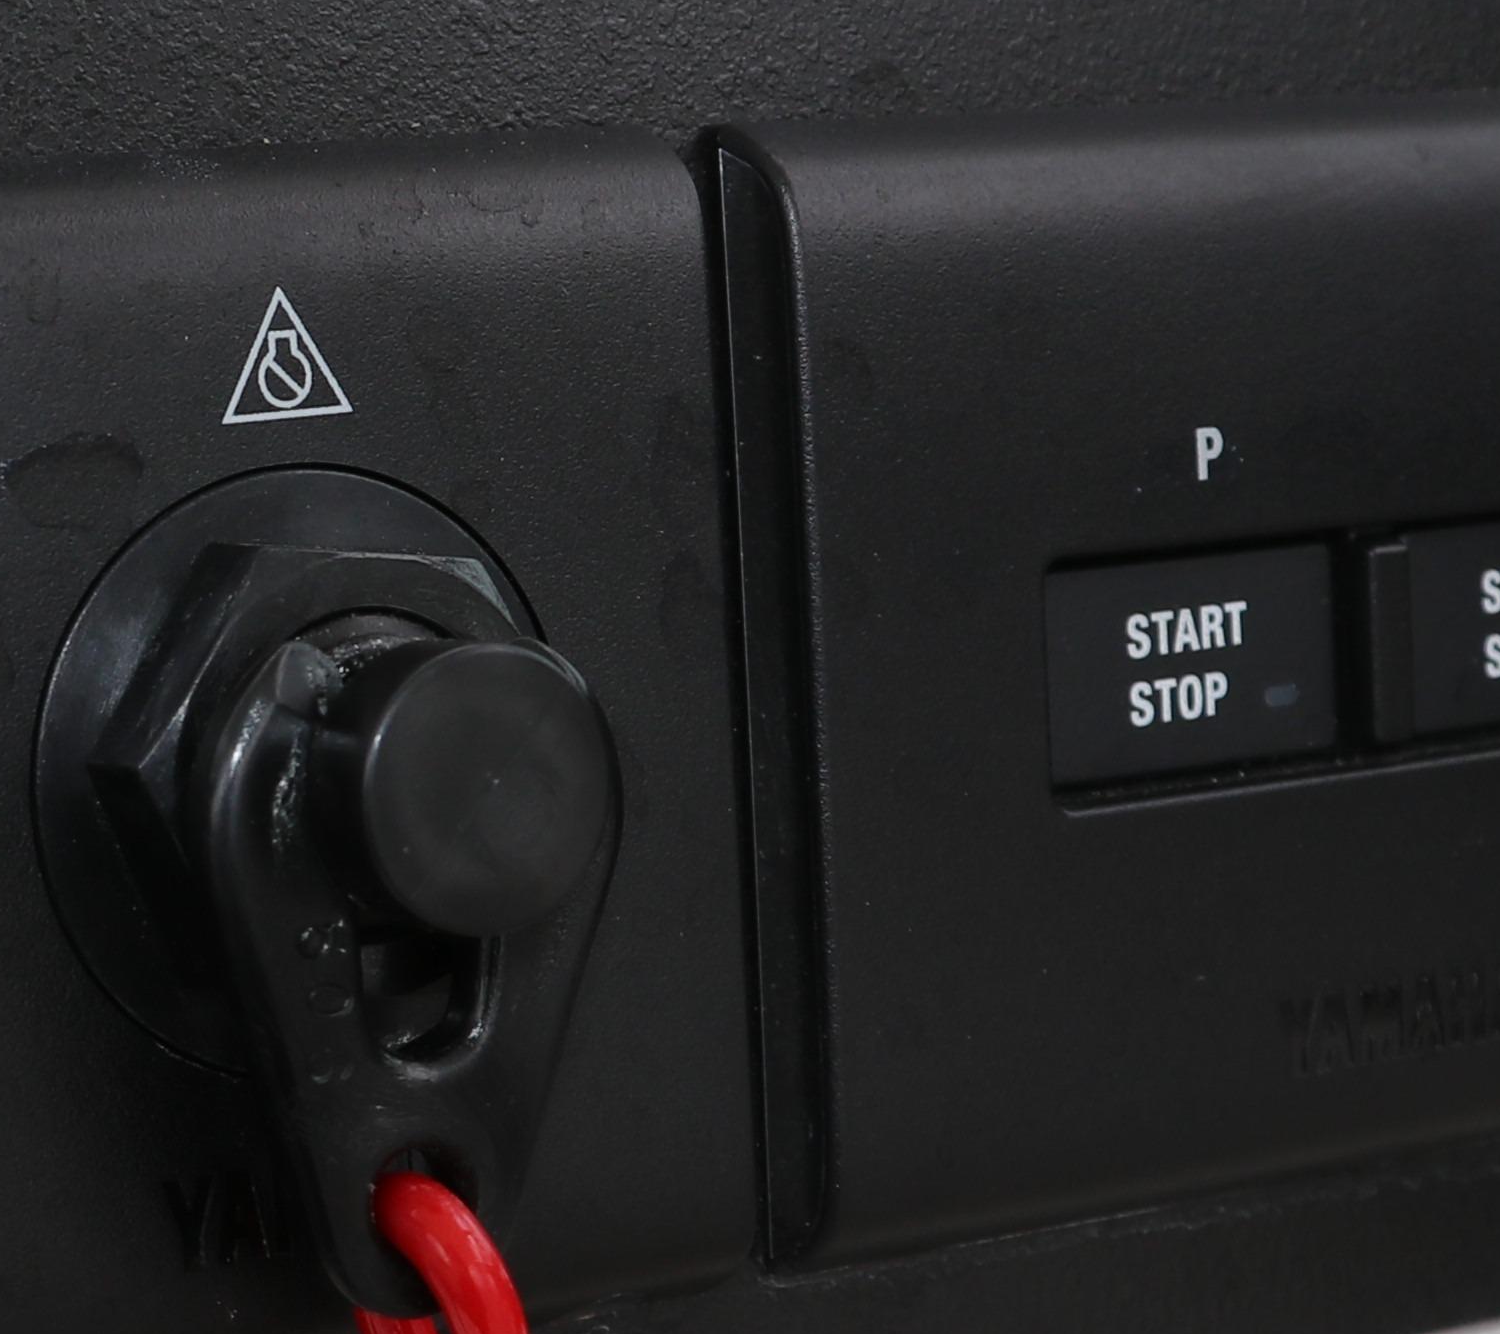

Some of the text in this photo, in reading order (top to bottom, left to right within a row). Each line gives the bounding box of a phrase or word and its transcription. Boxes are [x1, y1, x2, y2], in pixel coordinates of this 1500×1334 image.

[1195, 427, 1224, 481] P
[1126, 601, 1247, 660] START
[1129, 671, 1229, 728] STOP
